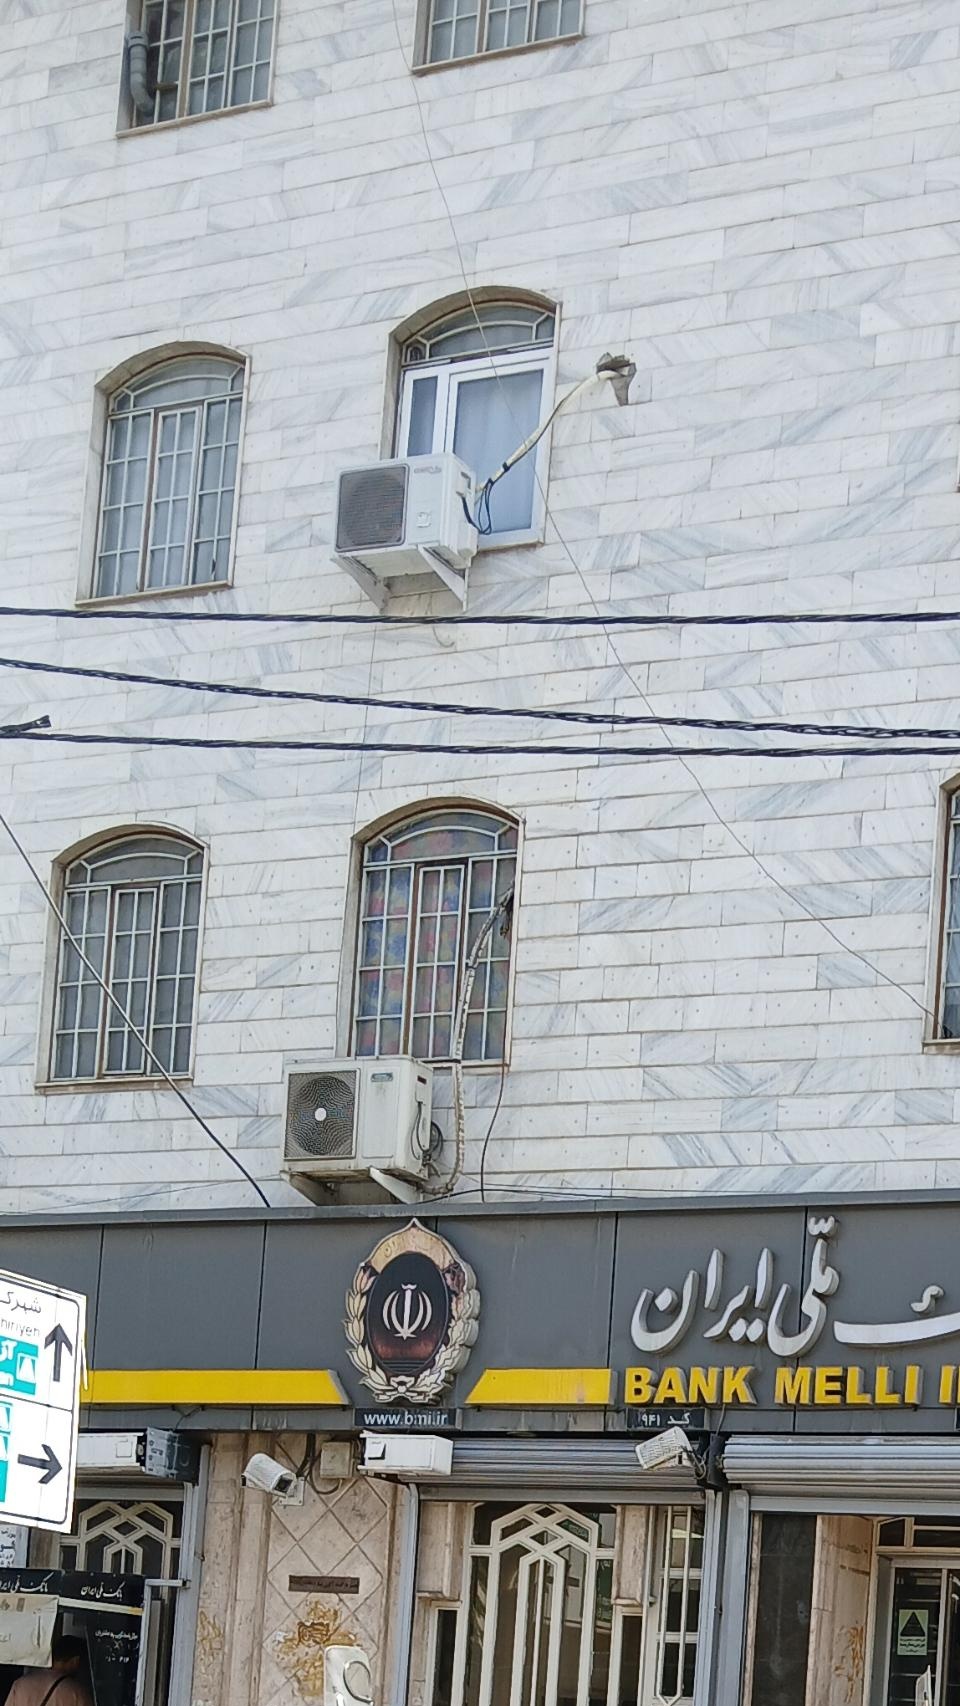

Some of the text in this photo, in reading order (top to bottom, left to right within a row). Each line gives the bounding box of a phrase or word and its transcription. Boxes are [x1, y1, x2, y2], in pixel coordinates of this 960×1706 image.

[631, 1247, 773, 1354] ایران
[624, 1366, 757, 1405] BANK
[774, 1364, 922, 1405] MELLI
[364, 1411, 449, 1426] www.bmi.ir
[667, 1412, 690, 1425] کد
